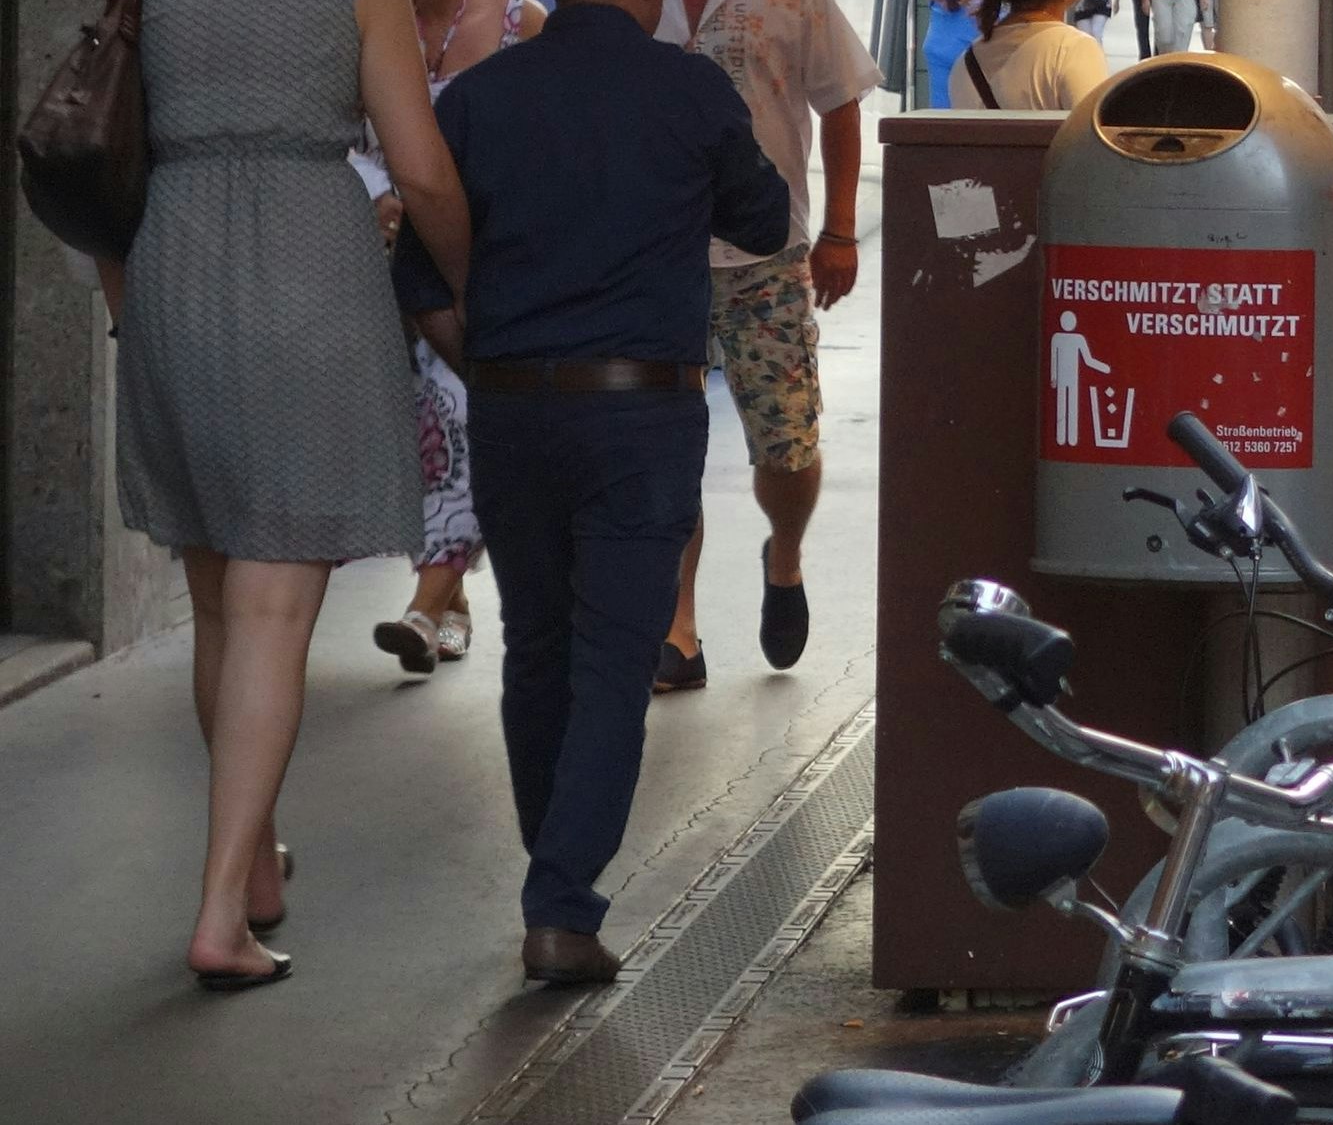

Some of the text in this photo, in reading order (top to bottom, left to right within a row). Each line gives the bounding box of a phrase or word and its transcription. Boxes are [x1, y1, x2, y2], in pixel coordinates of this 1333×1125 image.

[1051, 277, 1283, 306] VERSCHMITZT STATT
[1126, 312, 1300, 338] VERSCHMUTZT
[1216, 425, 1298, 437] Straßenbetrieb
[1219, 441, 1297, 453] 512 5360 7251
